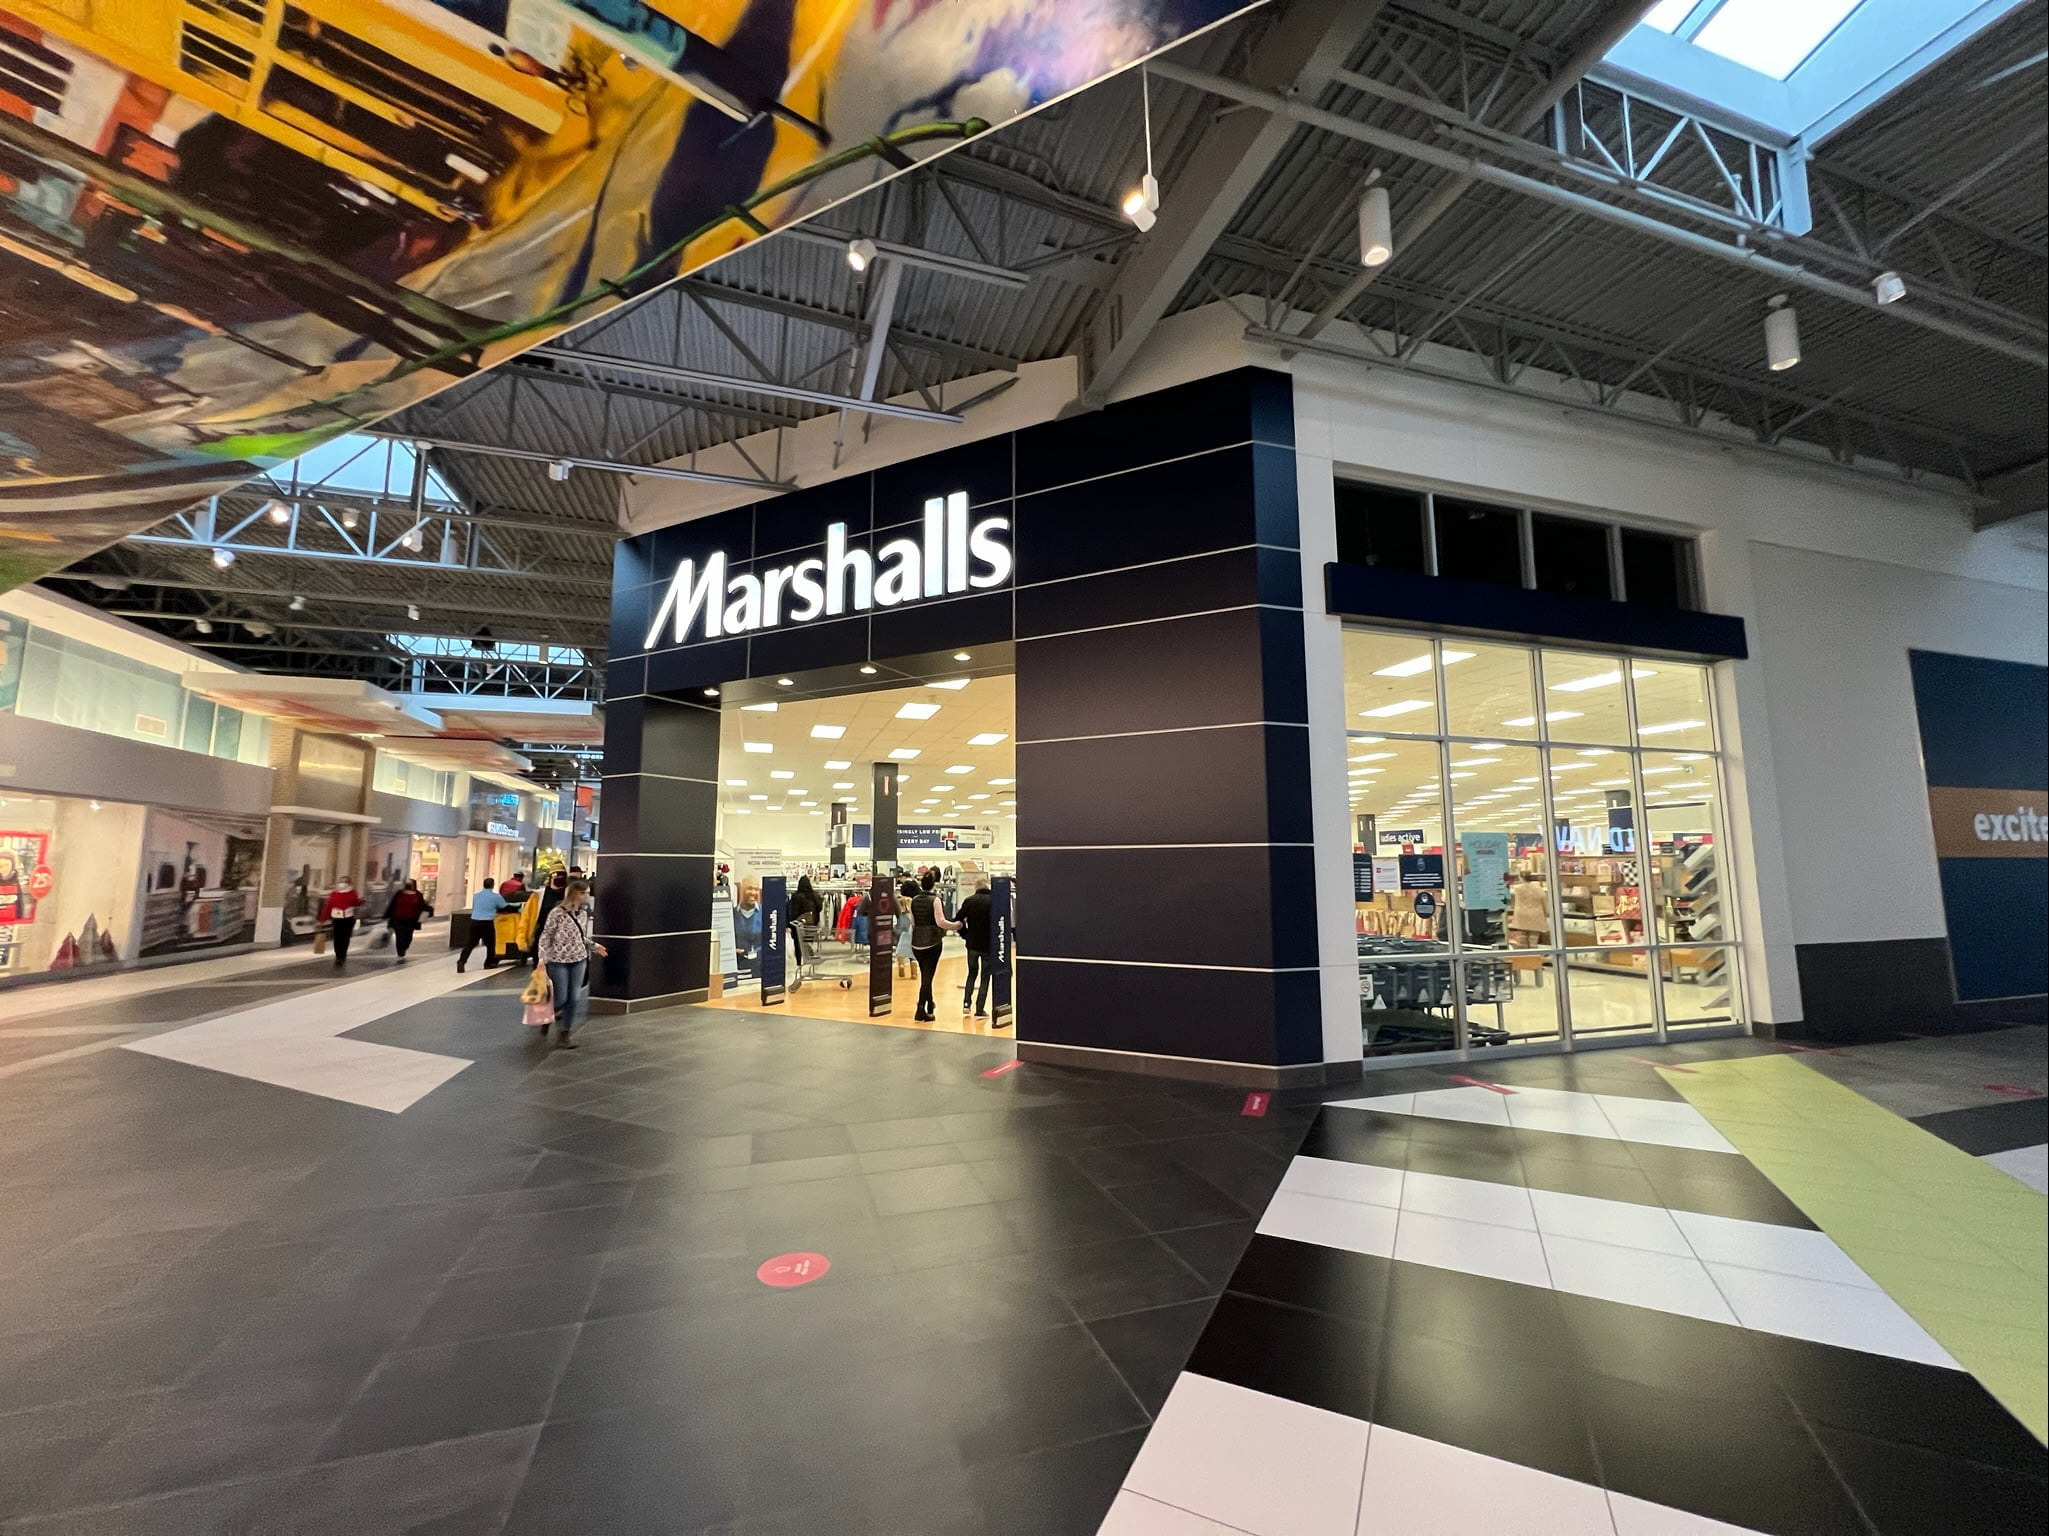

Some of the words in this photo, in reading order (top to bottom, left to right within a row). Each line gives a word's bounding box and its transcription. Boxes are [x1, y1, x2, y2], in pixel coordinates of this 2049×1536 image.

[643, 490, 1012, 650] Marshalls
[1398, 832, 1422, 843] active
[768, 909, 778, 951] Marshalls
[997, 916, 1006, 963] Marshalls
